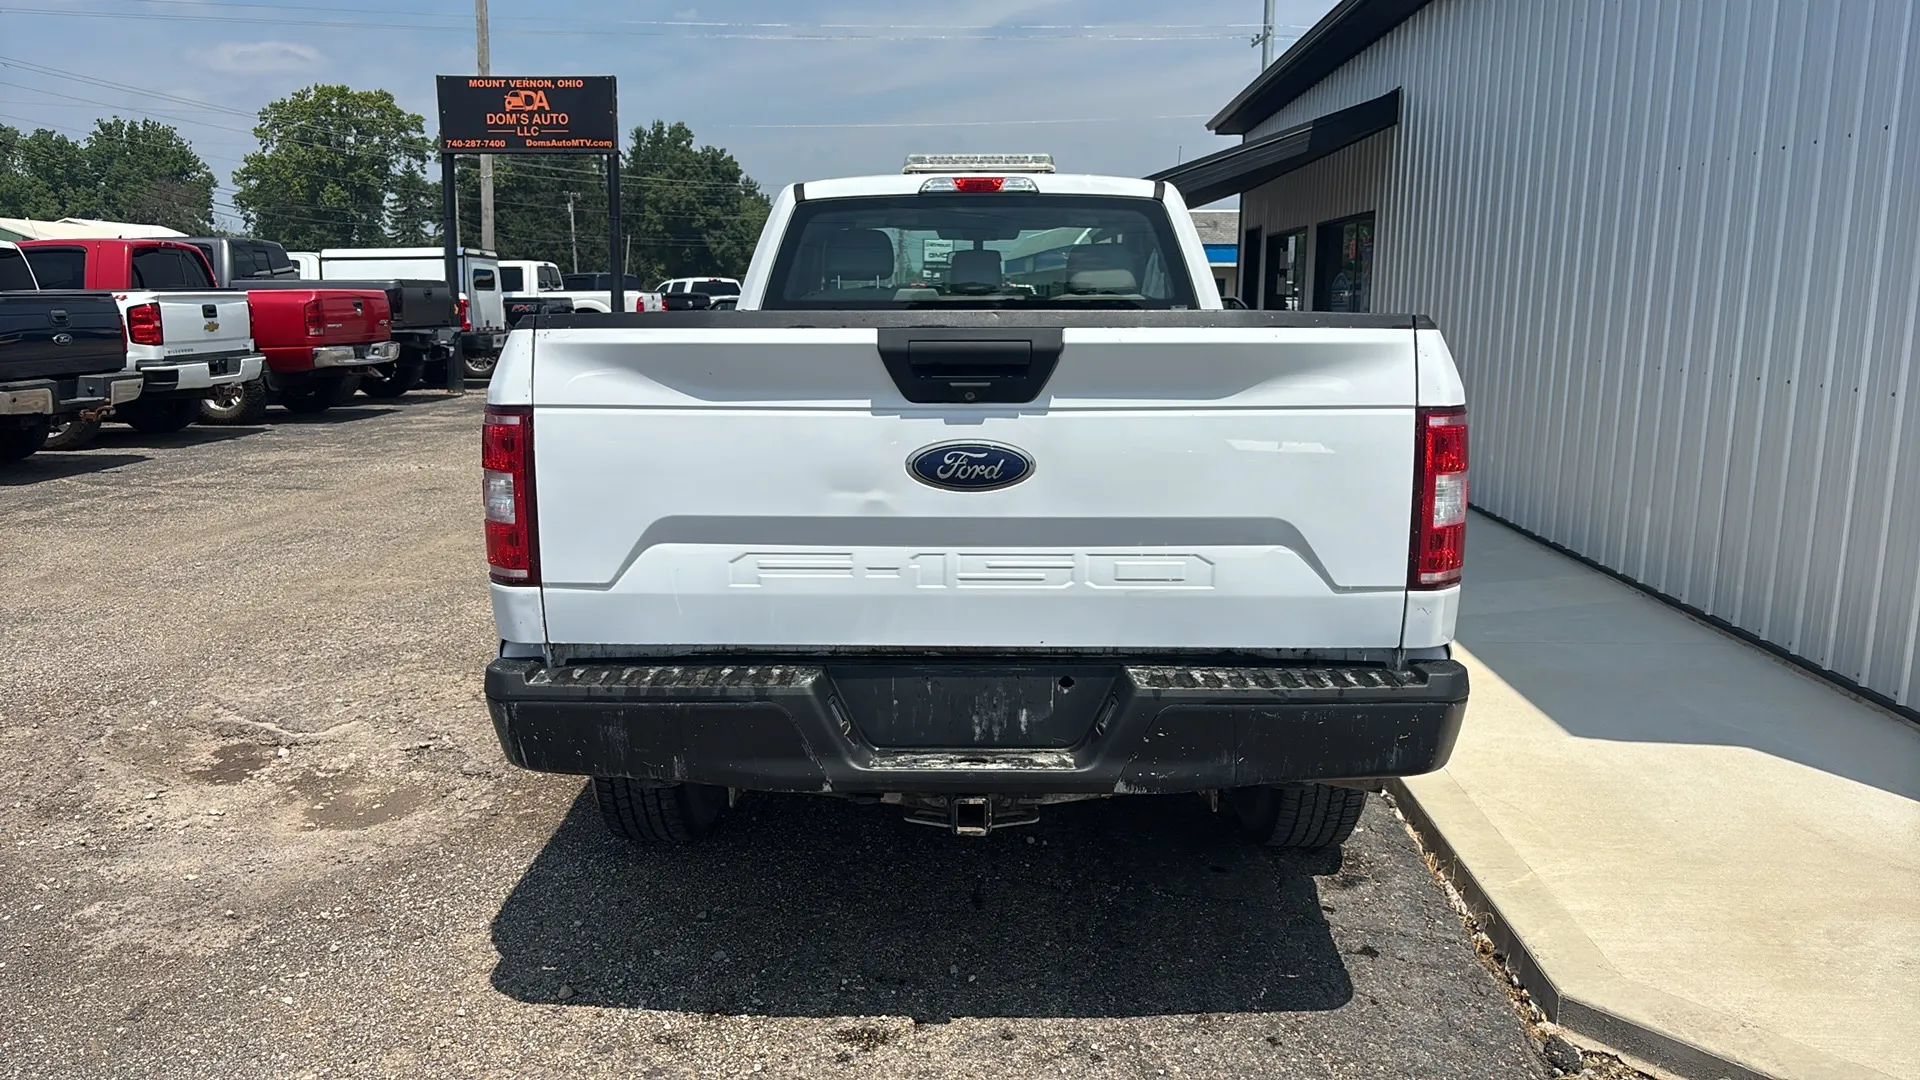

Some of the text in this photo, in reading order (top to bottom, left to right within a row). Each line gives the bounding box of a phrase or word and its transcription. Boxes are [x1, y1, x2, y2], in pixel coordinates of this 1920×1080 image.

[468, 79, 584, 89] MOUNT VERNON, OHIO
[486, 113, 569, 125] DOM'S AUTO
[516, 126, 540, 137] LLC
[445, 138, 613, 149] 740-287-7400 DomsAutoMTV.com
[936, 450, 1004, 481] Ford
[727, 551, 1216, 590] F-150
